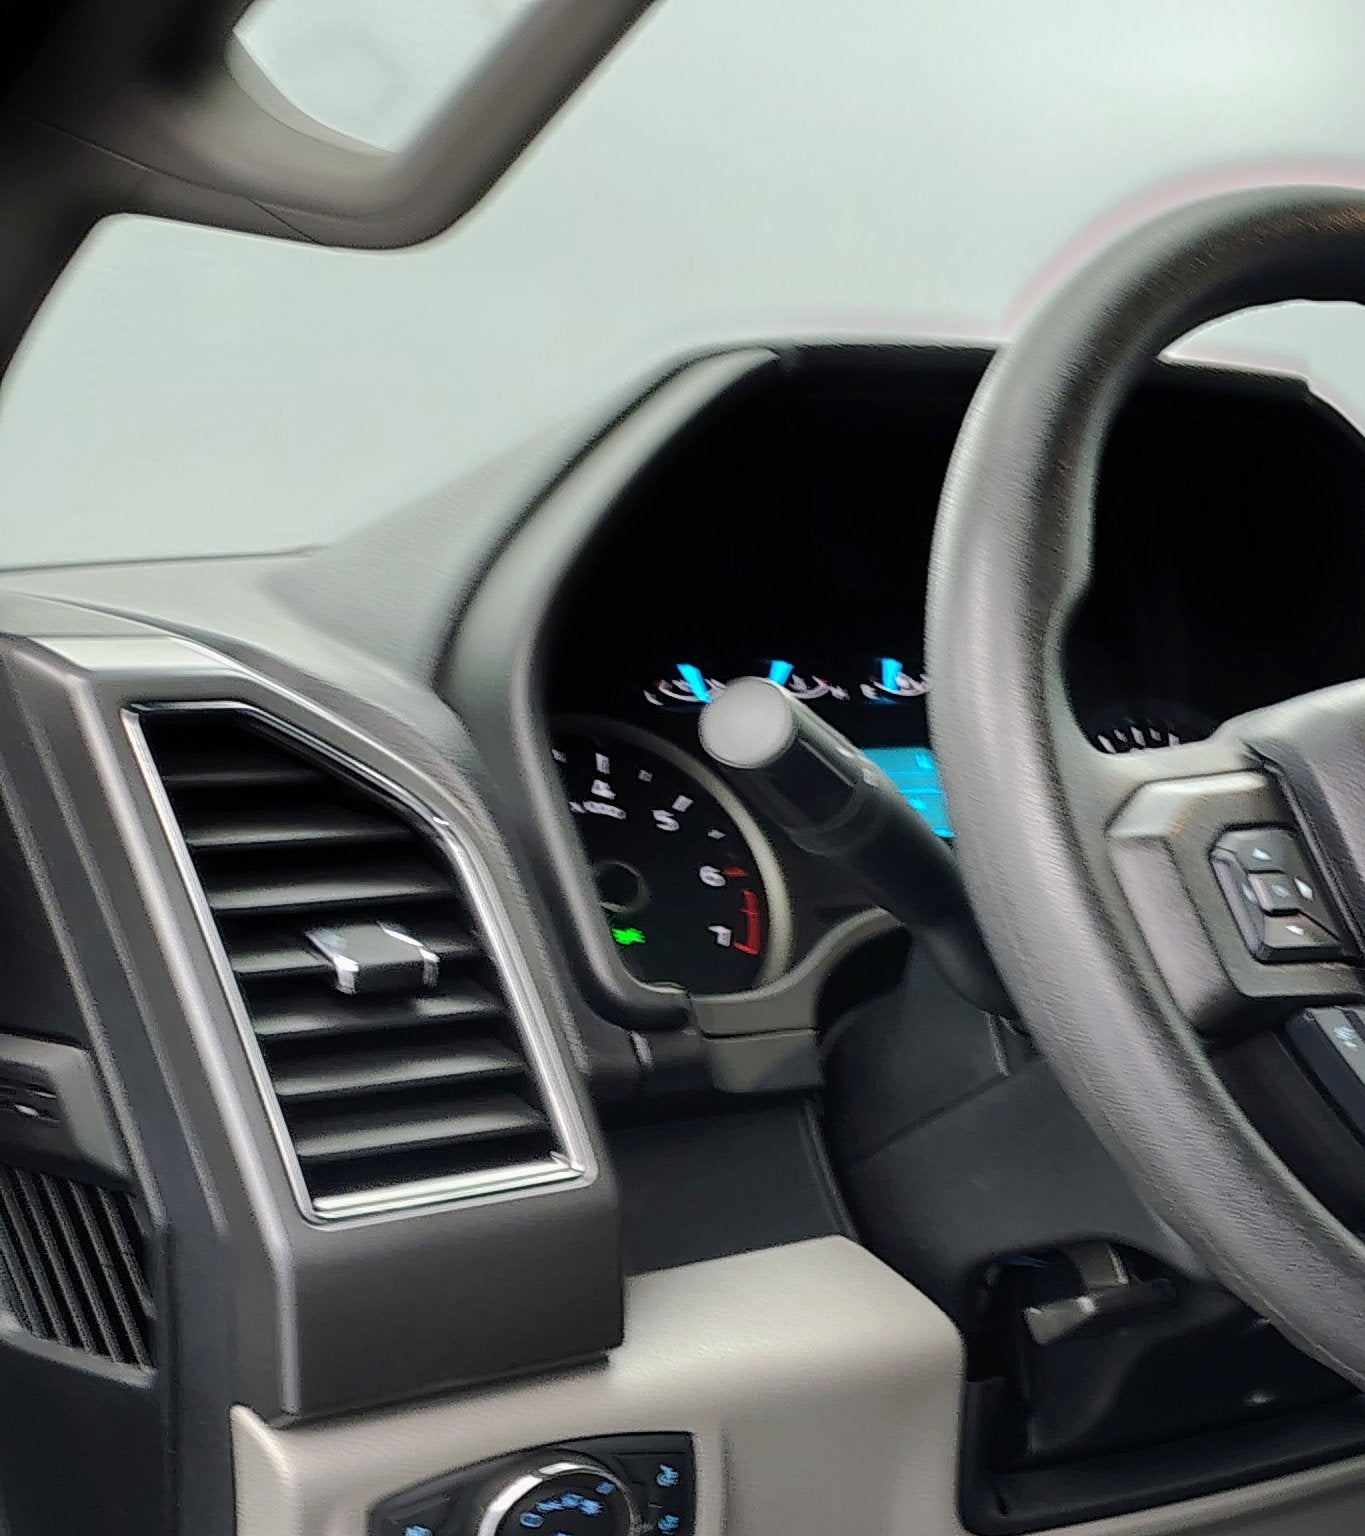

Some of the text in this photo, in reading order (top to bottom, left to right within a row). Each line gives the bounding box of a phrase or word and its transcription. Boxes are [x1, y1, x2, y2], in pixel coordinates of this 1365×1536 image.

[652, 809, 680, 831] 5
[699, 865, 726, 887] 6
[707, 925, 732, 947] 7
